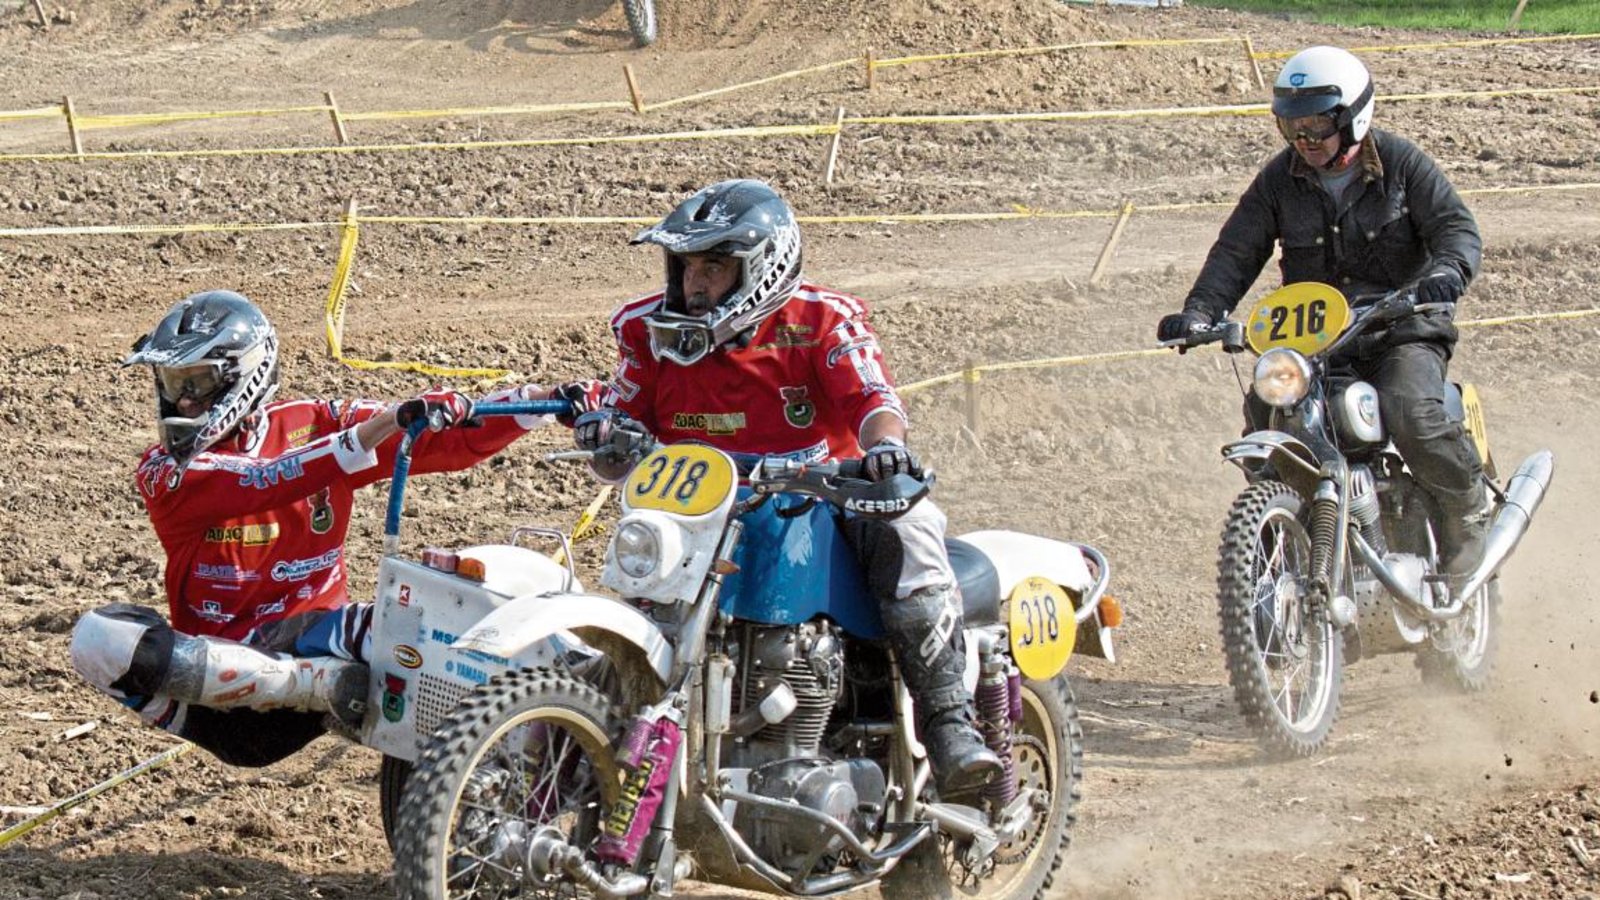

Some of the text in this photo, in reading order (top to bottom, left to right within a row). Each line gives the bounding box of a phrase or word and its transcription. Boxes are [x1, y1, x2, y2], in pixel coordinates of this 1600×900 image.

[1269, 299, 1326, 341] 216
[635, 455, 709, 500] 318
[207, 527, 243, 541] ADAC
[1020, 595, 1058, 646] 318
